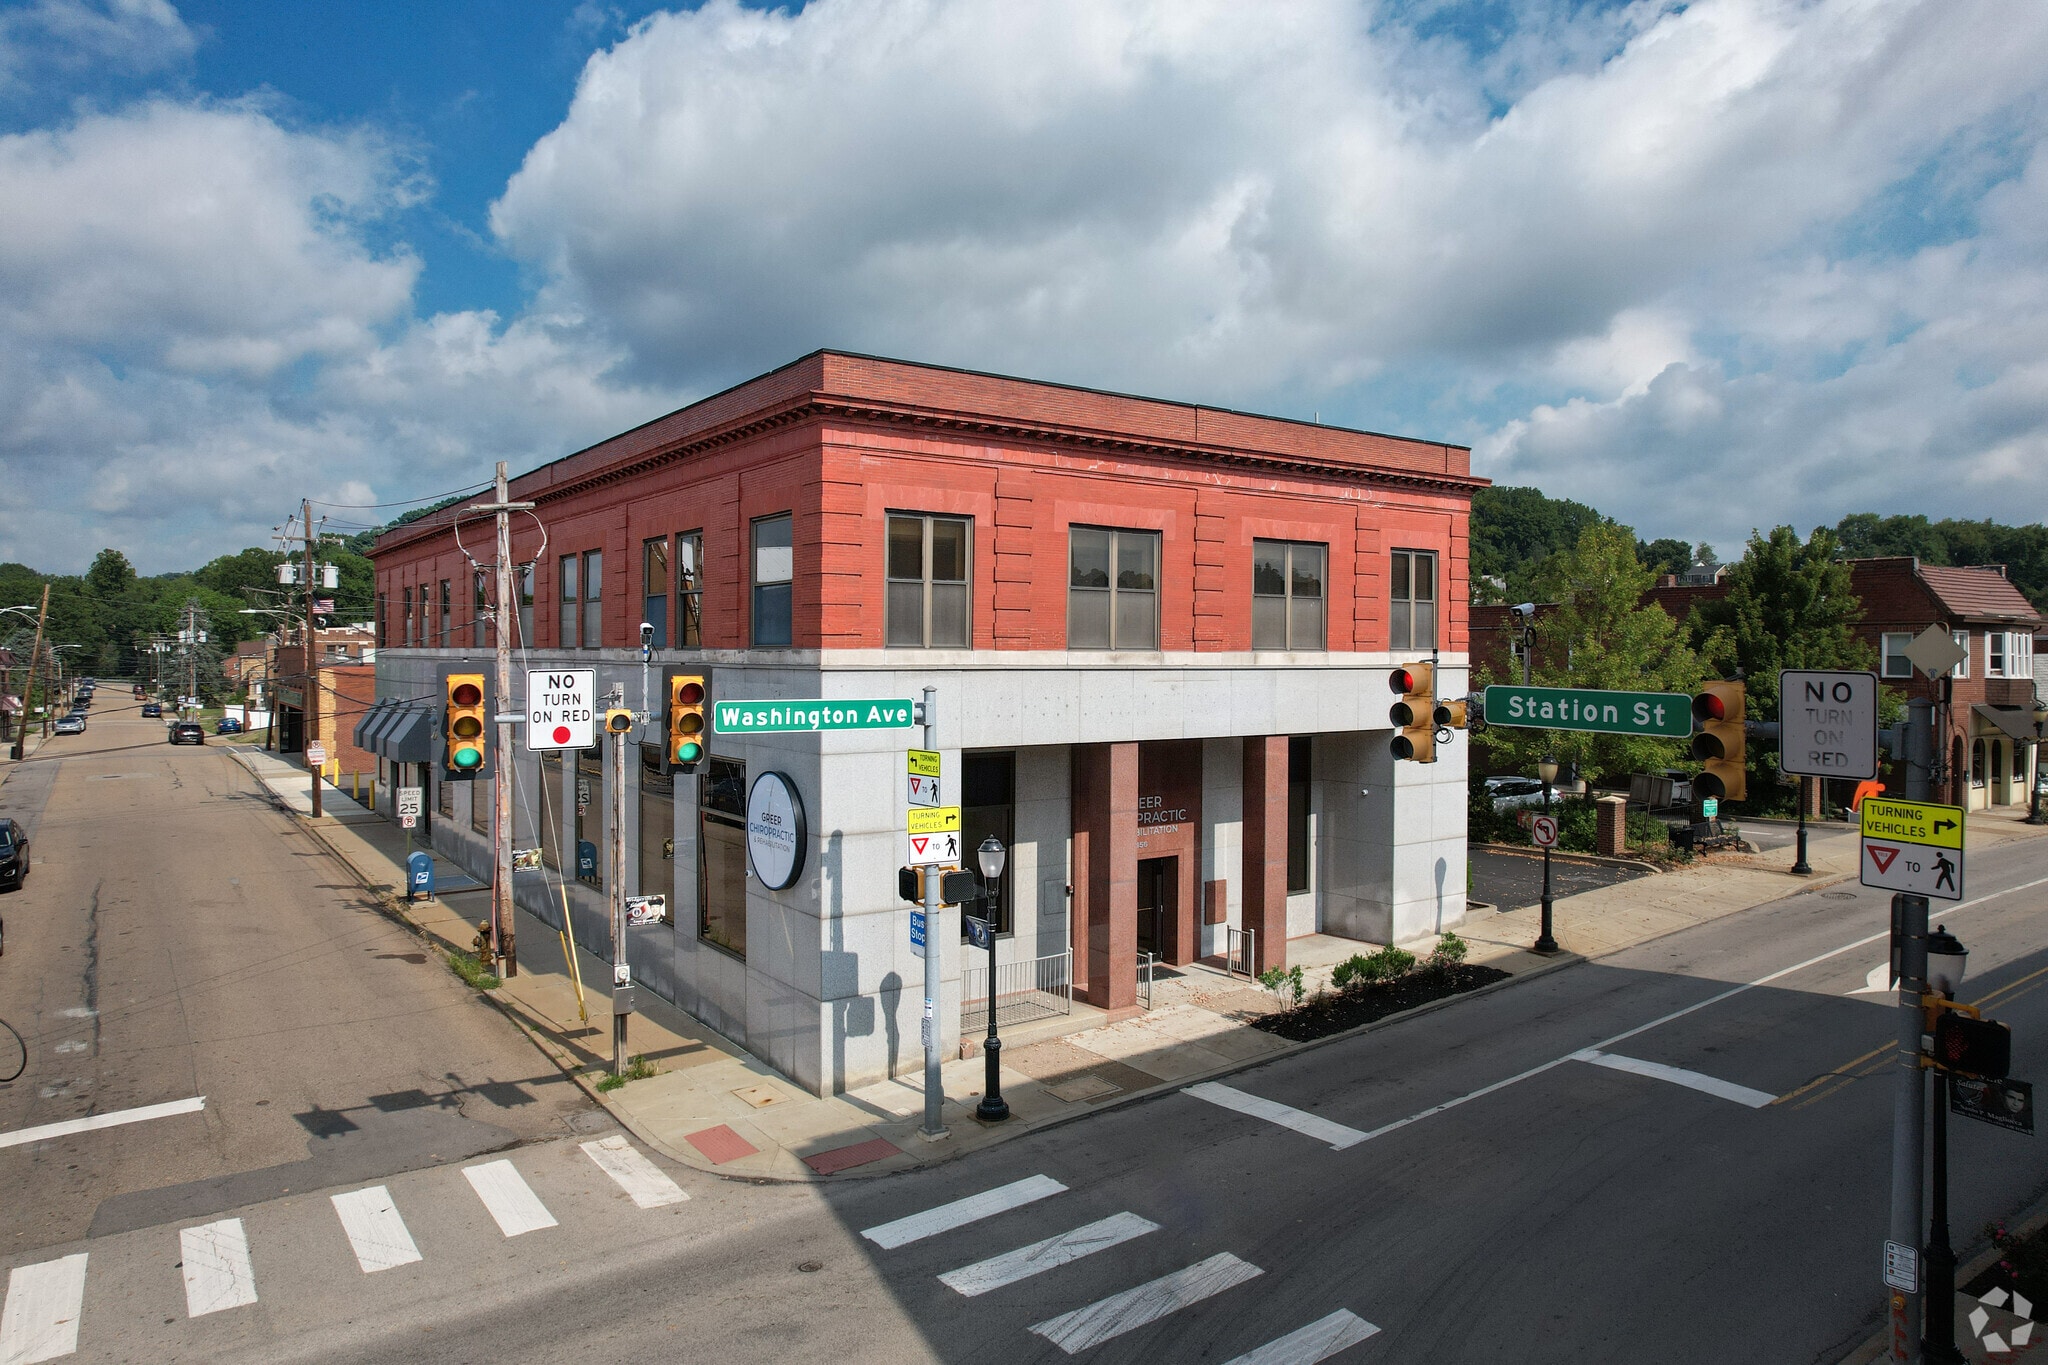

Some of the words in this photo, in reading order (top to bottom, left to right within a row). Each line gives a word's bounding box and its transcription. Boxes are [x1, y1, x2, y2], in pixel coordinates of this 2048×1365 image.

[548, 675, 575, 689] NO
[1805, 680, 1853, 704] NO
[542, 693, 582, 706] TURN
[532, 711, 553, 723] ON
[562, 709, 591, 723] RED
[721, 707, 858, 730] Washington
[866, 705, 908, 724] Ave
[1508, 696, 1618, 723] Station
[1632, 702, 1666, 727] St
[1805, 707, 1853, 726] TURN
[1813, 729, 1845, 747] ON
[919, 754, 938, 763] TURNING
[1808, 749, 1849, 769] RED
[918, 765, 939, 773] VEHICLES
[400, 803, 419, 814] 25
[1139, 796, 1162, 808] EER
[761, 812, 782, 827] GREER
[912, 811, 940, 820] TURNING
[1137, 809, 1187, 824] PRACTIC
[1870, 804, 1923, 821] TURNING
[749, 822, 794, 843] CHIROPRACTIC
[910, 821, 943, 830] VEHICLES
[1136, 824, 1178, 837] BILITATION
[1866, 820, 1926, 838] VEHICLES
[757, 837, 791, 853] REHABILITATION
[932, 843, 940, 851] TO
[1905, 860, 1921, 874] TO
[912, 915, 925, 929] Bus
[911, 927, 925, 944] Stop
